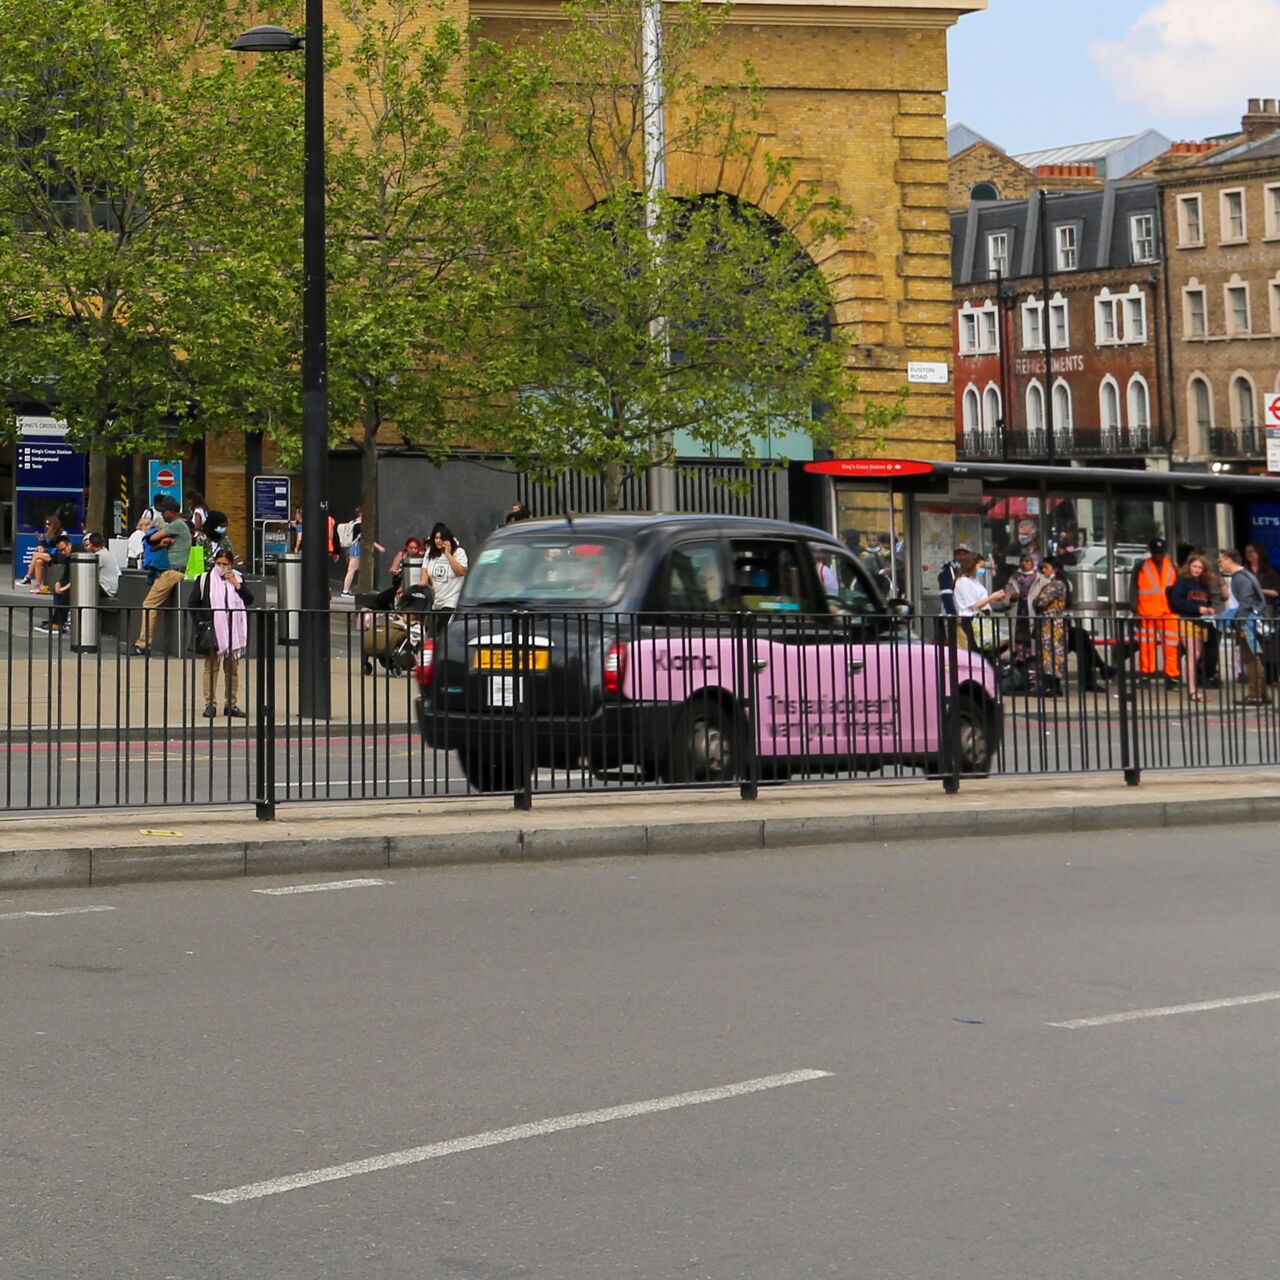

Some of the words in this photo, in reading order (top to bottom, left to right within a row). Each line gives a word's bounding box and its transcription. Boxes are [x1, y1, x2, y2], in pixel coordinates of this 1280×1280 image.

[1016, 355, 1084, 374] REFRESMENTS
[1252, 516, 1280, 526] LET'S
[650, 649, 719, 670] Kana.
[767, 694, 797, 714] Ths
